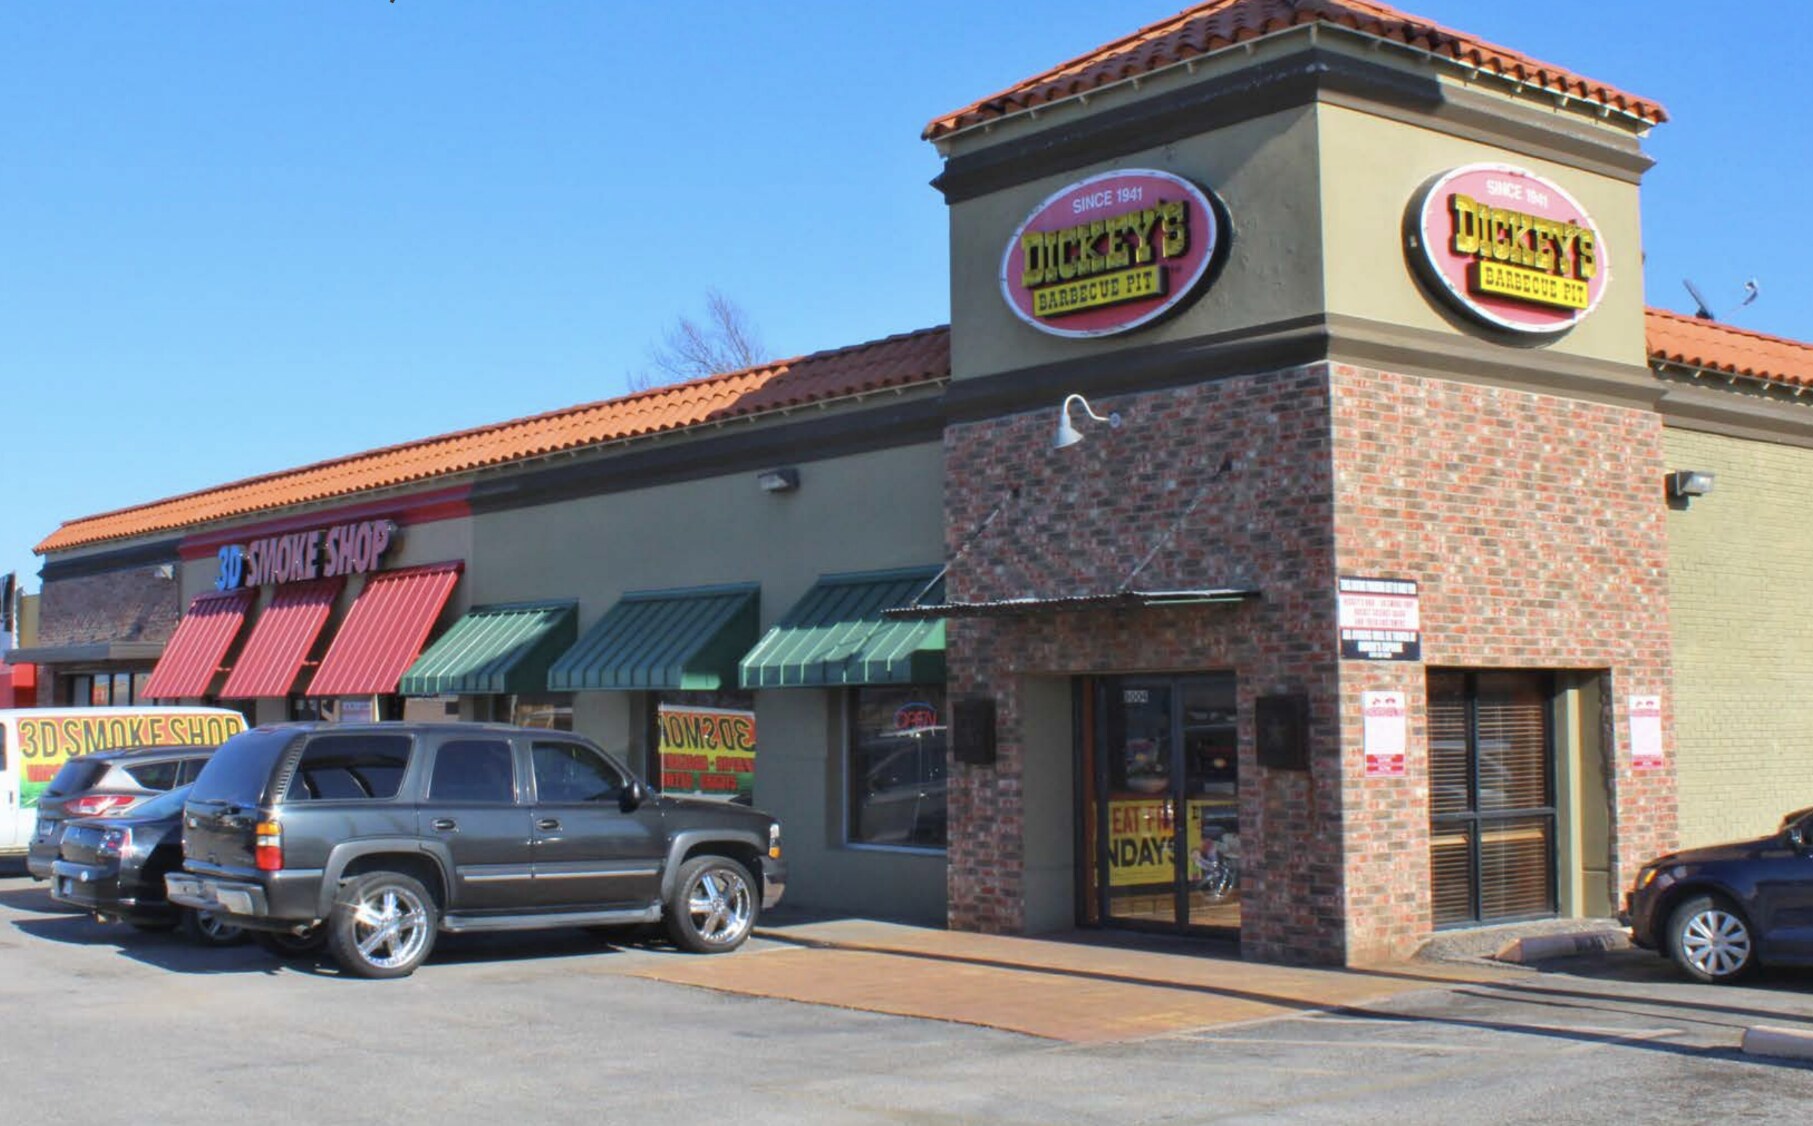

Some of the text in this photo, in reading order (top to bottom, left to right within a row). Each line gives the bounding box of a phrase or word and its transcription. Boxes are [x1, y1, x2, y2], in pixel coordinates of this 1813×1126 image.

[1072, 186, 1143, 213] SINCE 1941
[1486, 179, 1524, 200] SINCE
[1021, 198, 1188, 287] DICKEY'S
[1449, 193, 1597, 279] DICKEY'S
[1038, 271, 1153, 311] BARBECUE PIT
[1485, 266, 1584, 303] BARBECUE PIT
[216, 519, 393, 591] 3D SMOKE SHOP
[20, 715, 241, 758] 3D SMOKE SHOP
[895, 711, 937, 730] OPEN
[1112, 806, 1139, 834] EAT
